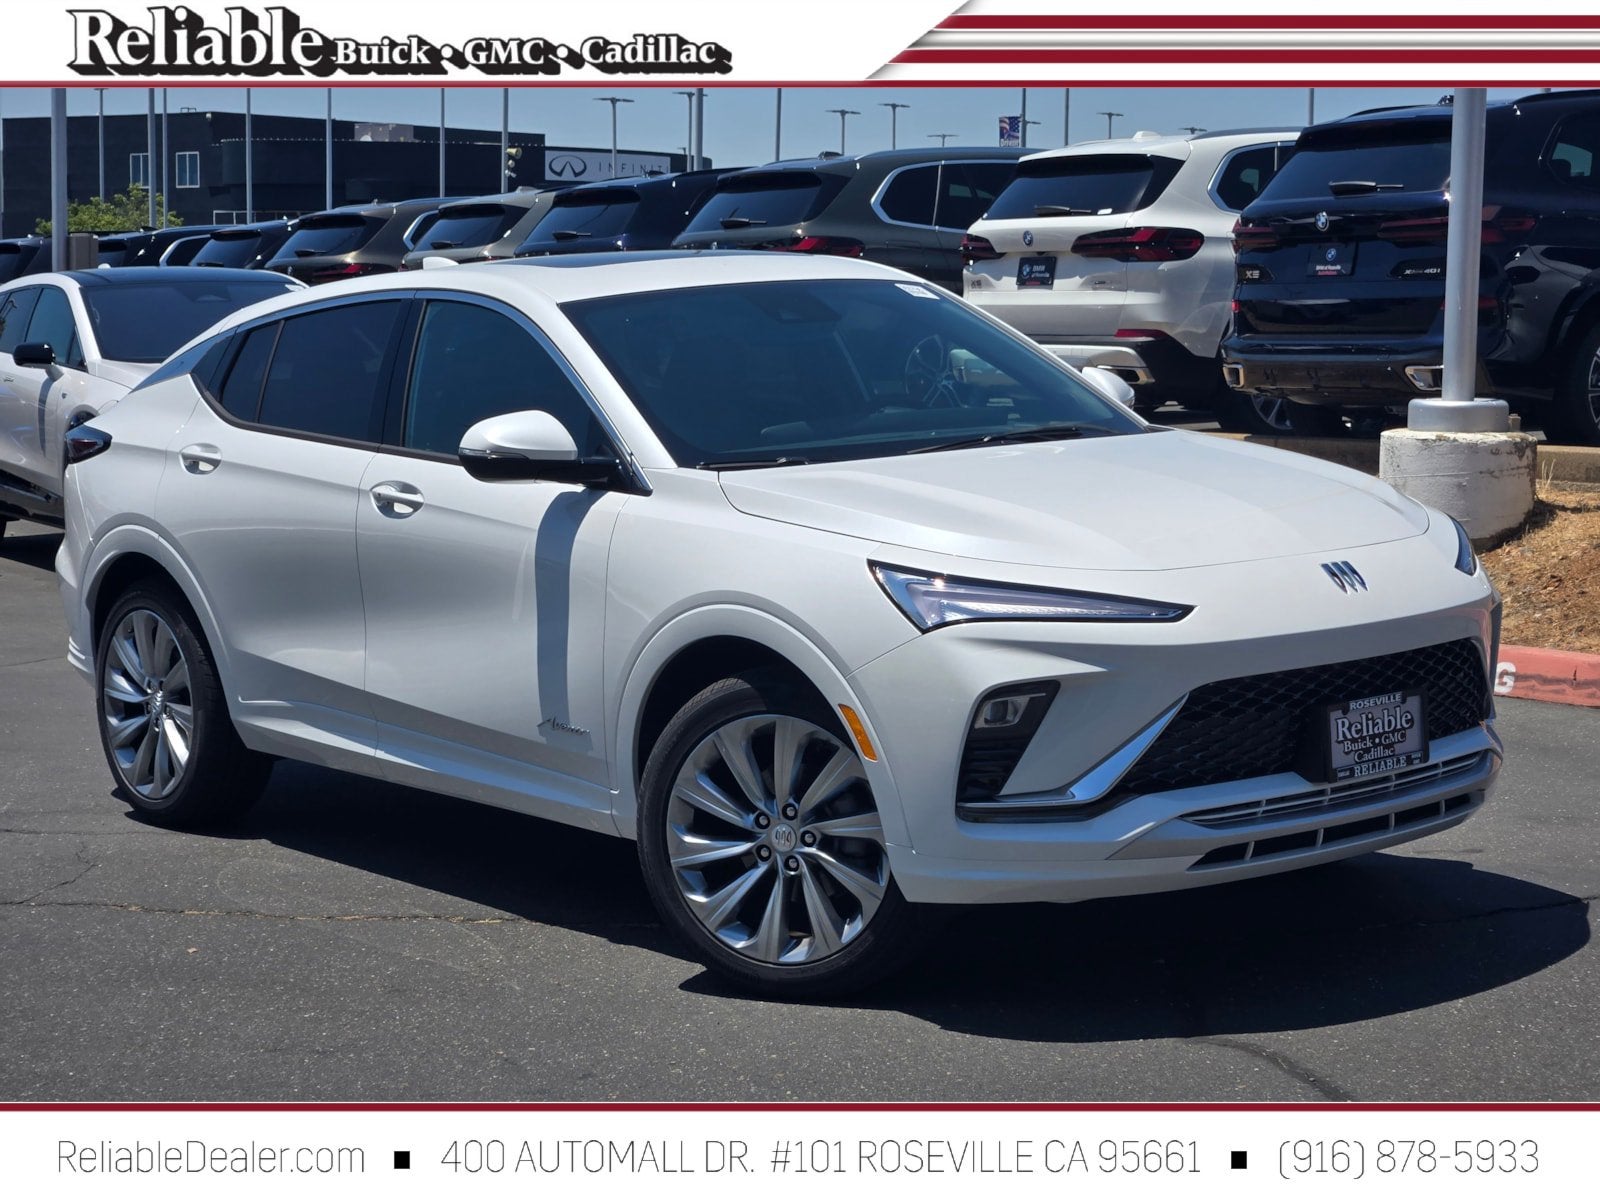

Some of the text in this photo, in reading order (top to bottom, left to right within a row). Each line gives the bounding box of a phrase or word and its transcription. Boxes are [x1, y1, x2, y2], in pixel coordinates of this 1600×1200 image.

[1349, 693, 1402, 711] ROSEVILLE
[1336, 705, 1413, 741] Reliable
[1343, 730, 1406, 753] Buick GMC
[1354, 746, 1395, 763] Cadillac
[1353, 755, 1407, 777] RELIABLE
